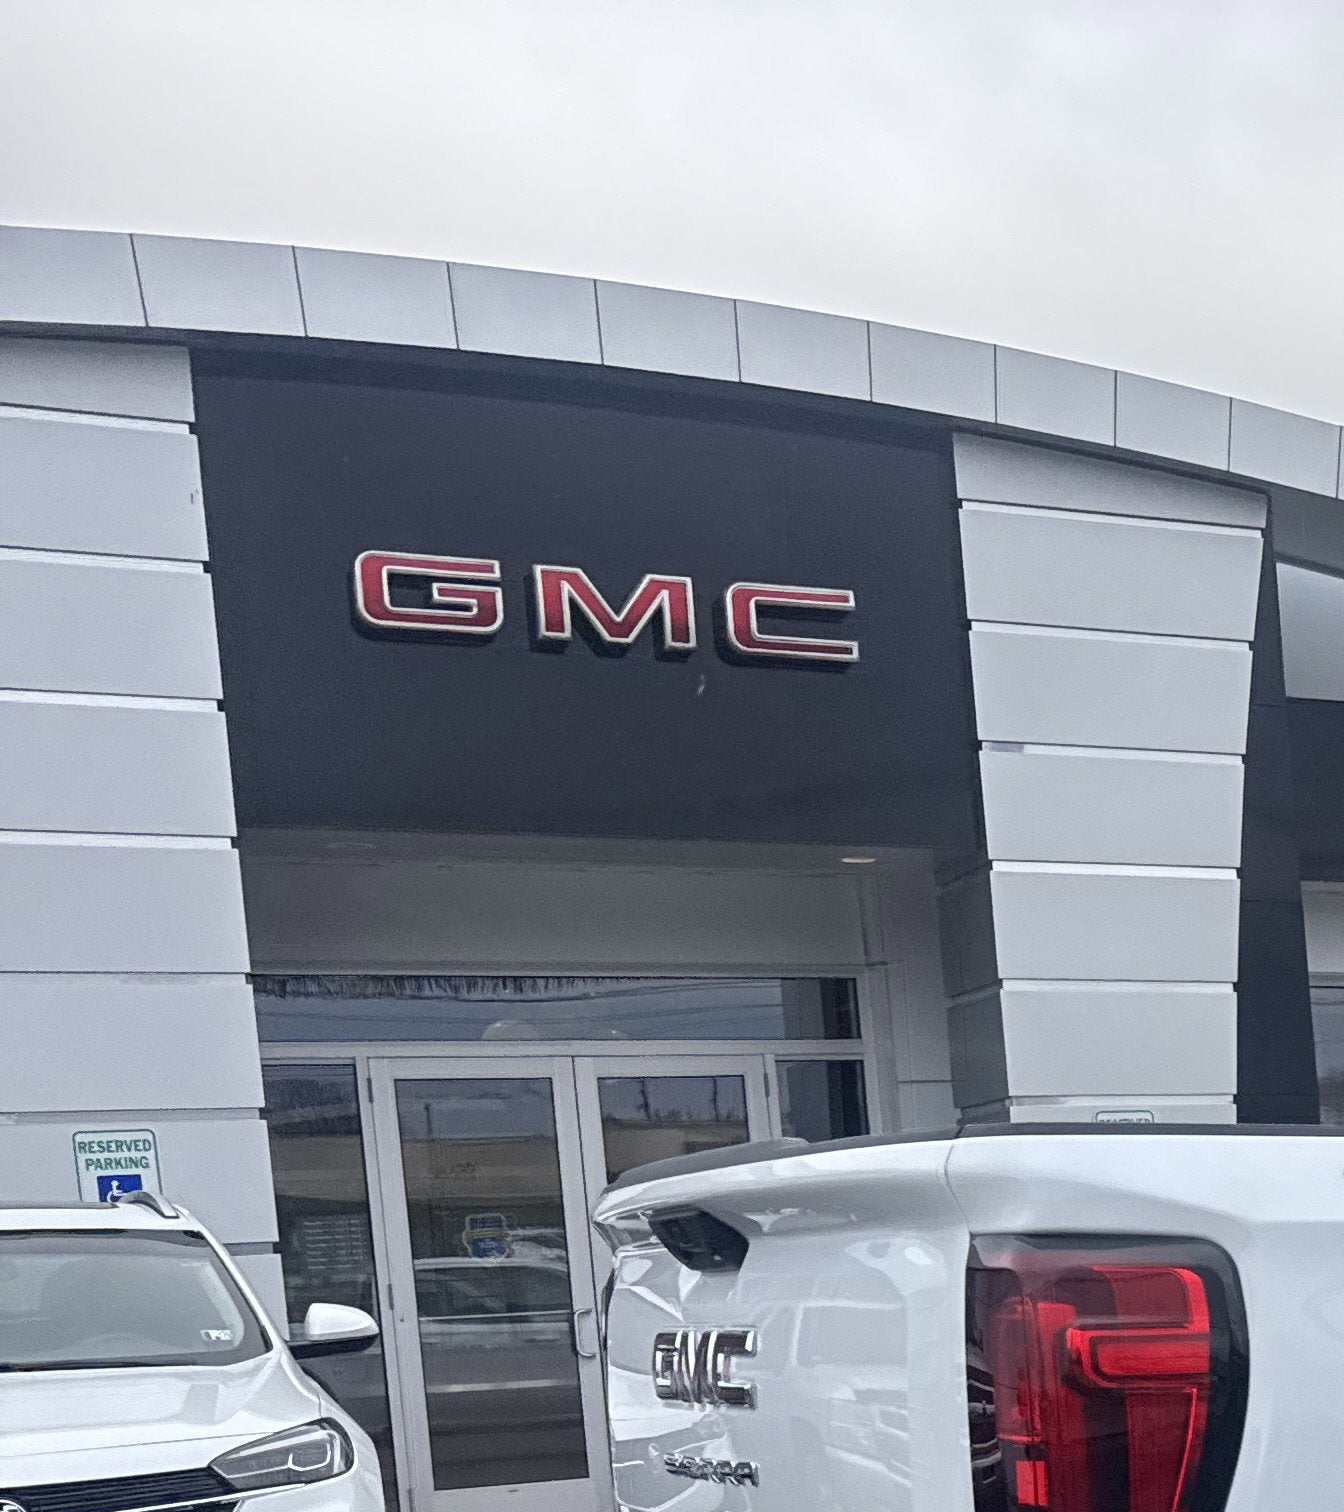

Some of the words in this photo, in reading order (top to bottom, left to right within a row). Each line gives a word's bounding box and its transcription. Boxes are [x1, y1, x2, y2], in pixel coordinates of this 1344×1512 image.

[355, 549, 859, 662] GMC
[77, 1138, 152, 1154] RESERVED
[84, 1155, 151, 1171] PARKING
[652, 1329, 758, 1410] GMC
